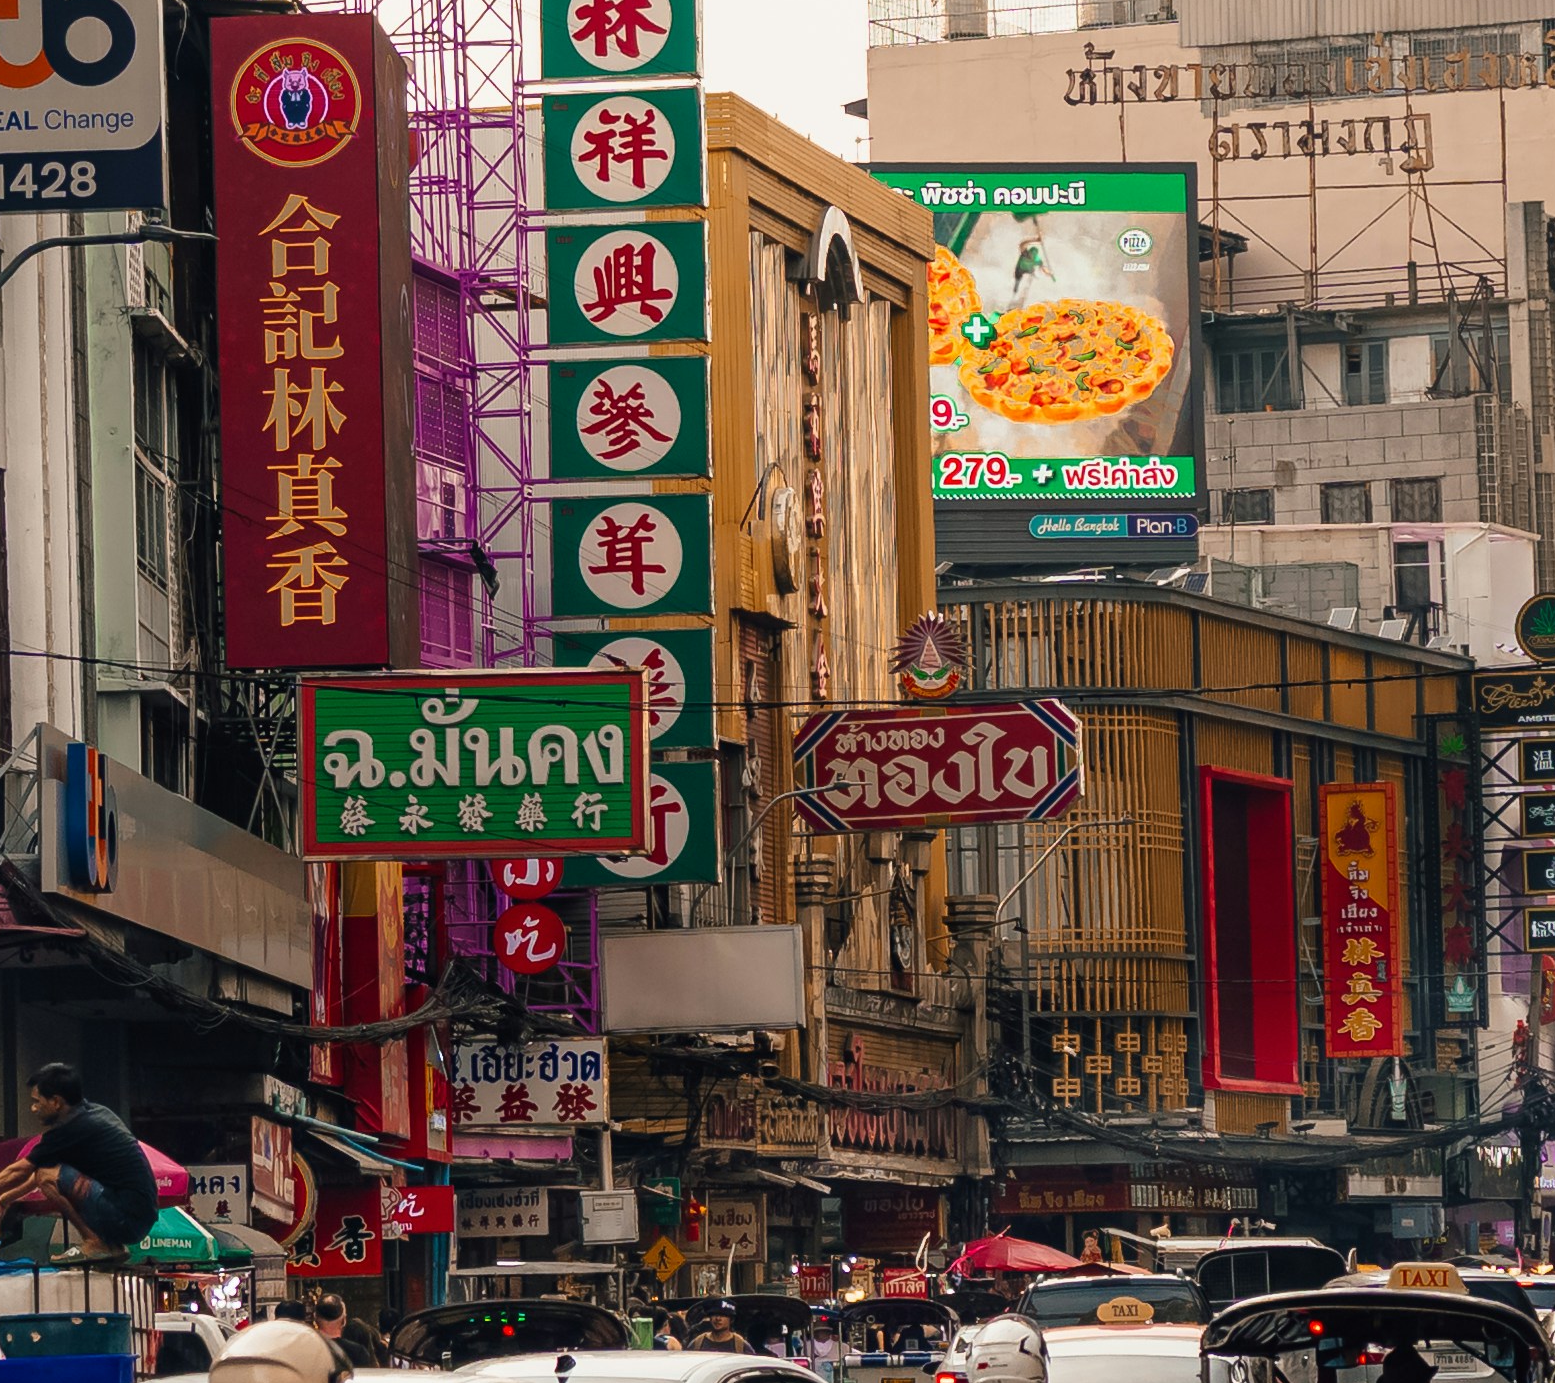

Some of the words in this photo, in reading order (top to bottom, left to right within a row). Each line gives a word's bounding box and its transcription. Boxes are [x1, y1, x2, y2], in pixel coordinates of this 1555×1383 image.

[44, 108, 135, 135] Change
[920, 179, 987, 206] พิซซ่า
[993, 180, 1087, 207] คอมปะนี
[254, 192, 356, 628] 合記林真香
[941, 456, 1023, 487] 279.-
[1063, 461, 1178, 489] ฟรี!ค่าส่ง
[1037, 517, 1073, 534] Hello
[1074, 517, 1121, 534] Bangkok
[321, 687, 626, 791] ฉ.มั่นคง
[835, 708, 946, 754] ห้างทอง
[824, 721, 1051, 812] ทองใบ
[151, 1237, 193, 1249] LINEMAN
[1399, 1268, 1450, 1288] TAXI
[1111, 1303, 1139, 1318] TAXI
